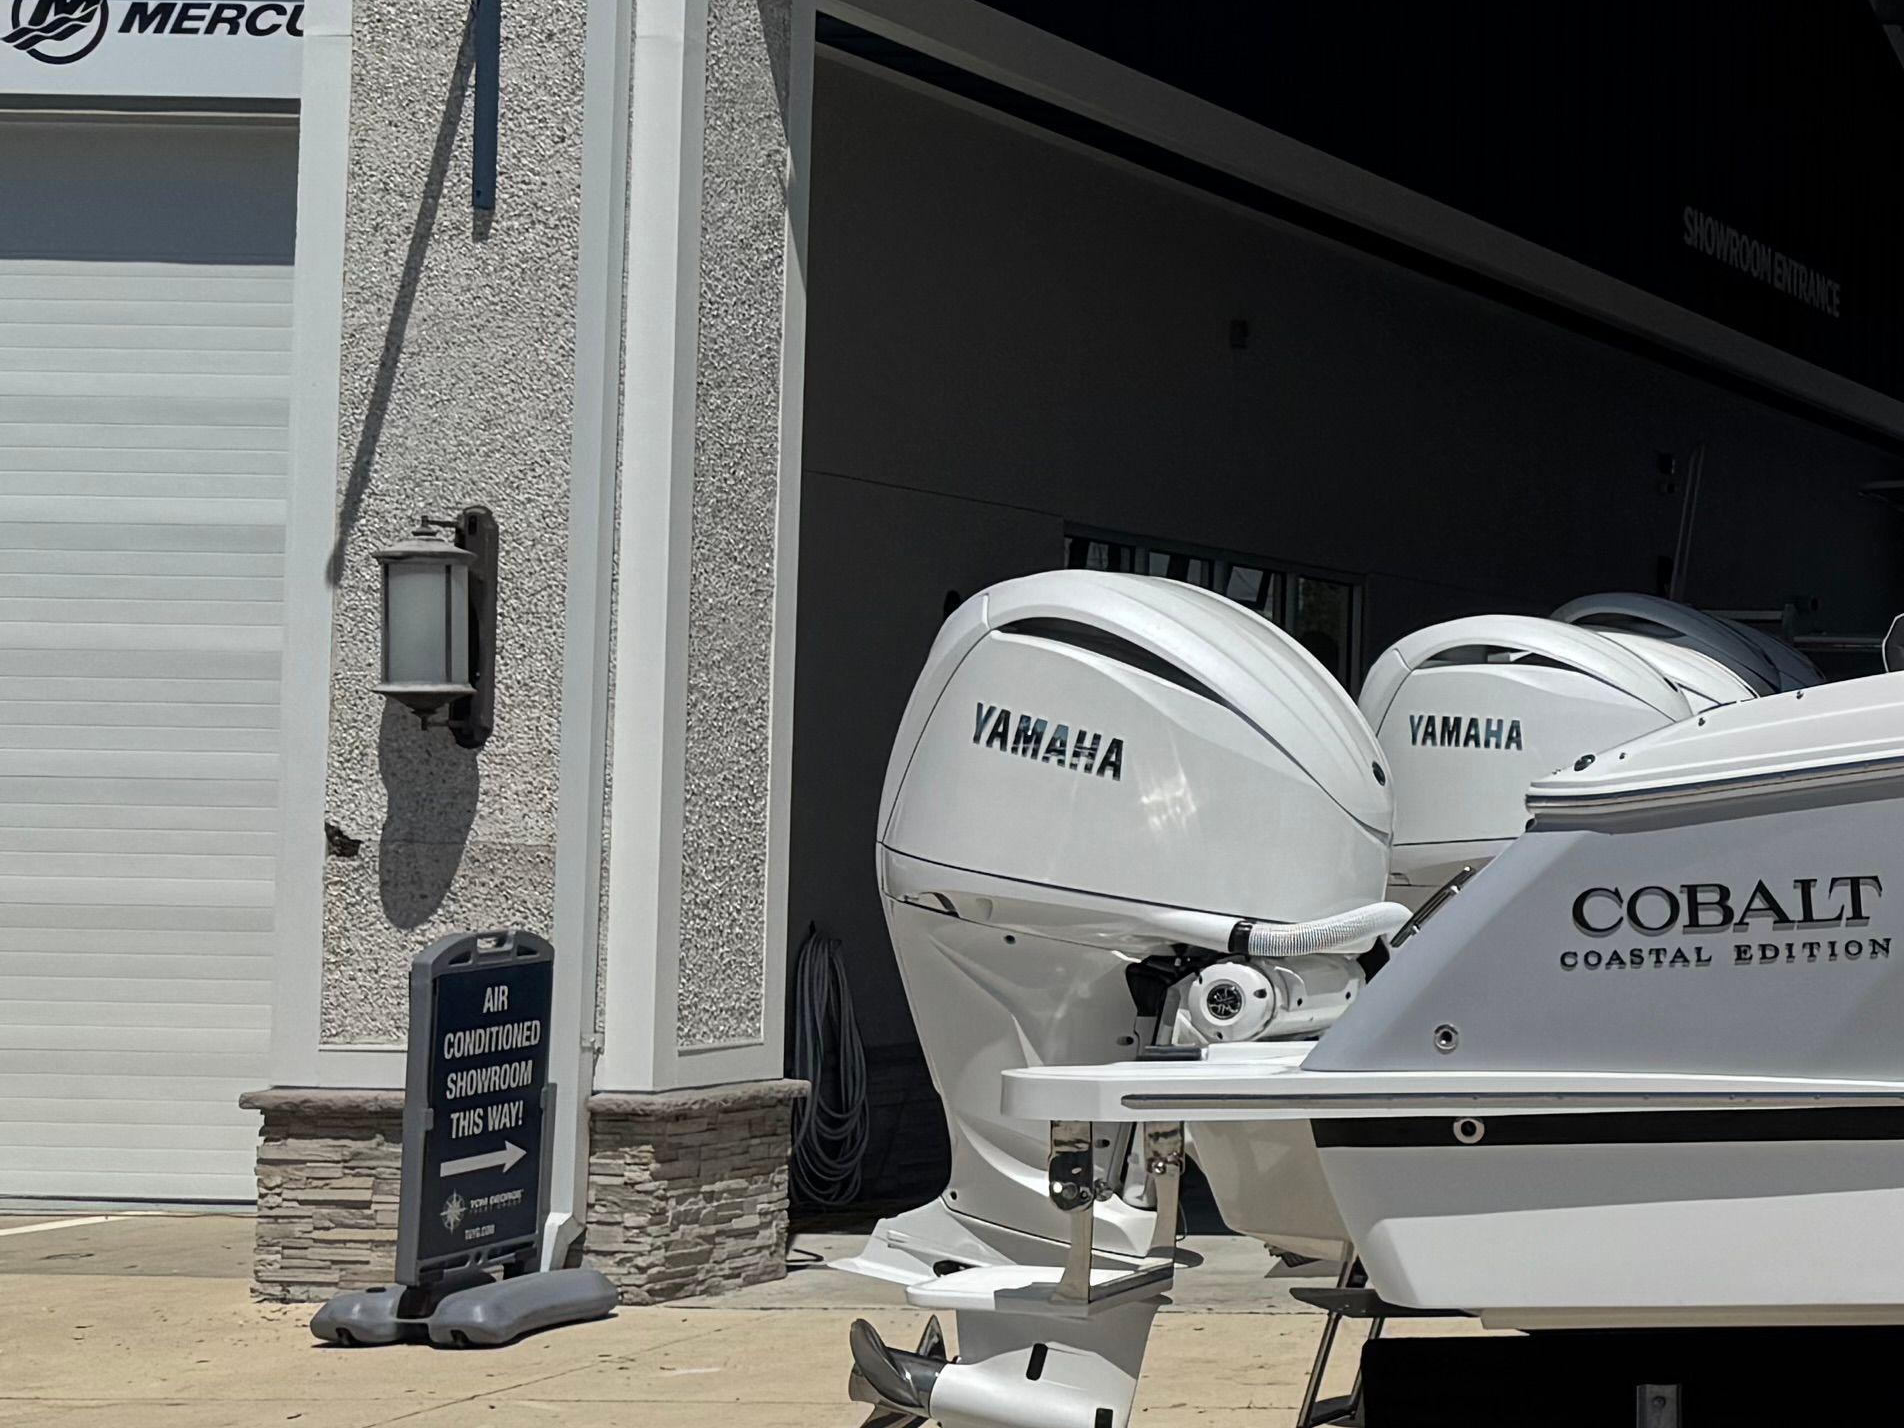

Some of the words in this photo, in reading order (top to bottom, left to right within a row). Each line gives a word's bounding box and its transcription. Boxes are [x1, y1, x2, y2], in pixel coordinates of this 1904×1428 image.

[1683, 205, 1772, 285] SHOWROOM
[1773, 251, 1841, 319] ENTRANCE
[971, 702, 1124, 782] YAMAHA
[1408, 714, 1524, 751] YAMAHA
[1571, 875, 1884, 937] COBALT
[1559, 947, 1713, 971] COASTAL
[1733, 938, 1892, 966] EDITION
[483, 985, 509, 1014] AIR
[443, 1020, 541, 1060] CONDITIONED
[446, 1059, 533, 1100] SHOWROOM
[450, 1108, 484, 1139] THIS
[487, 1100, 524, 1133] WAY!
